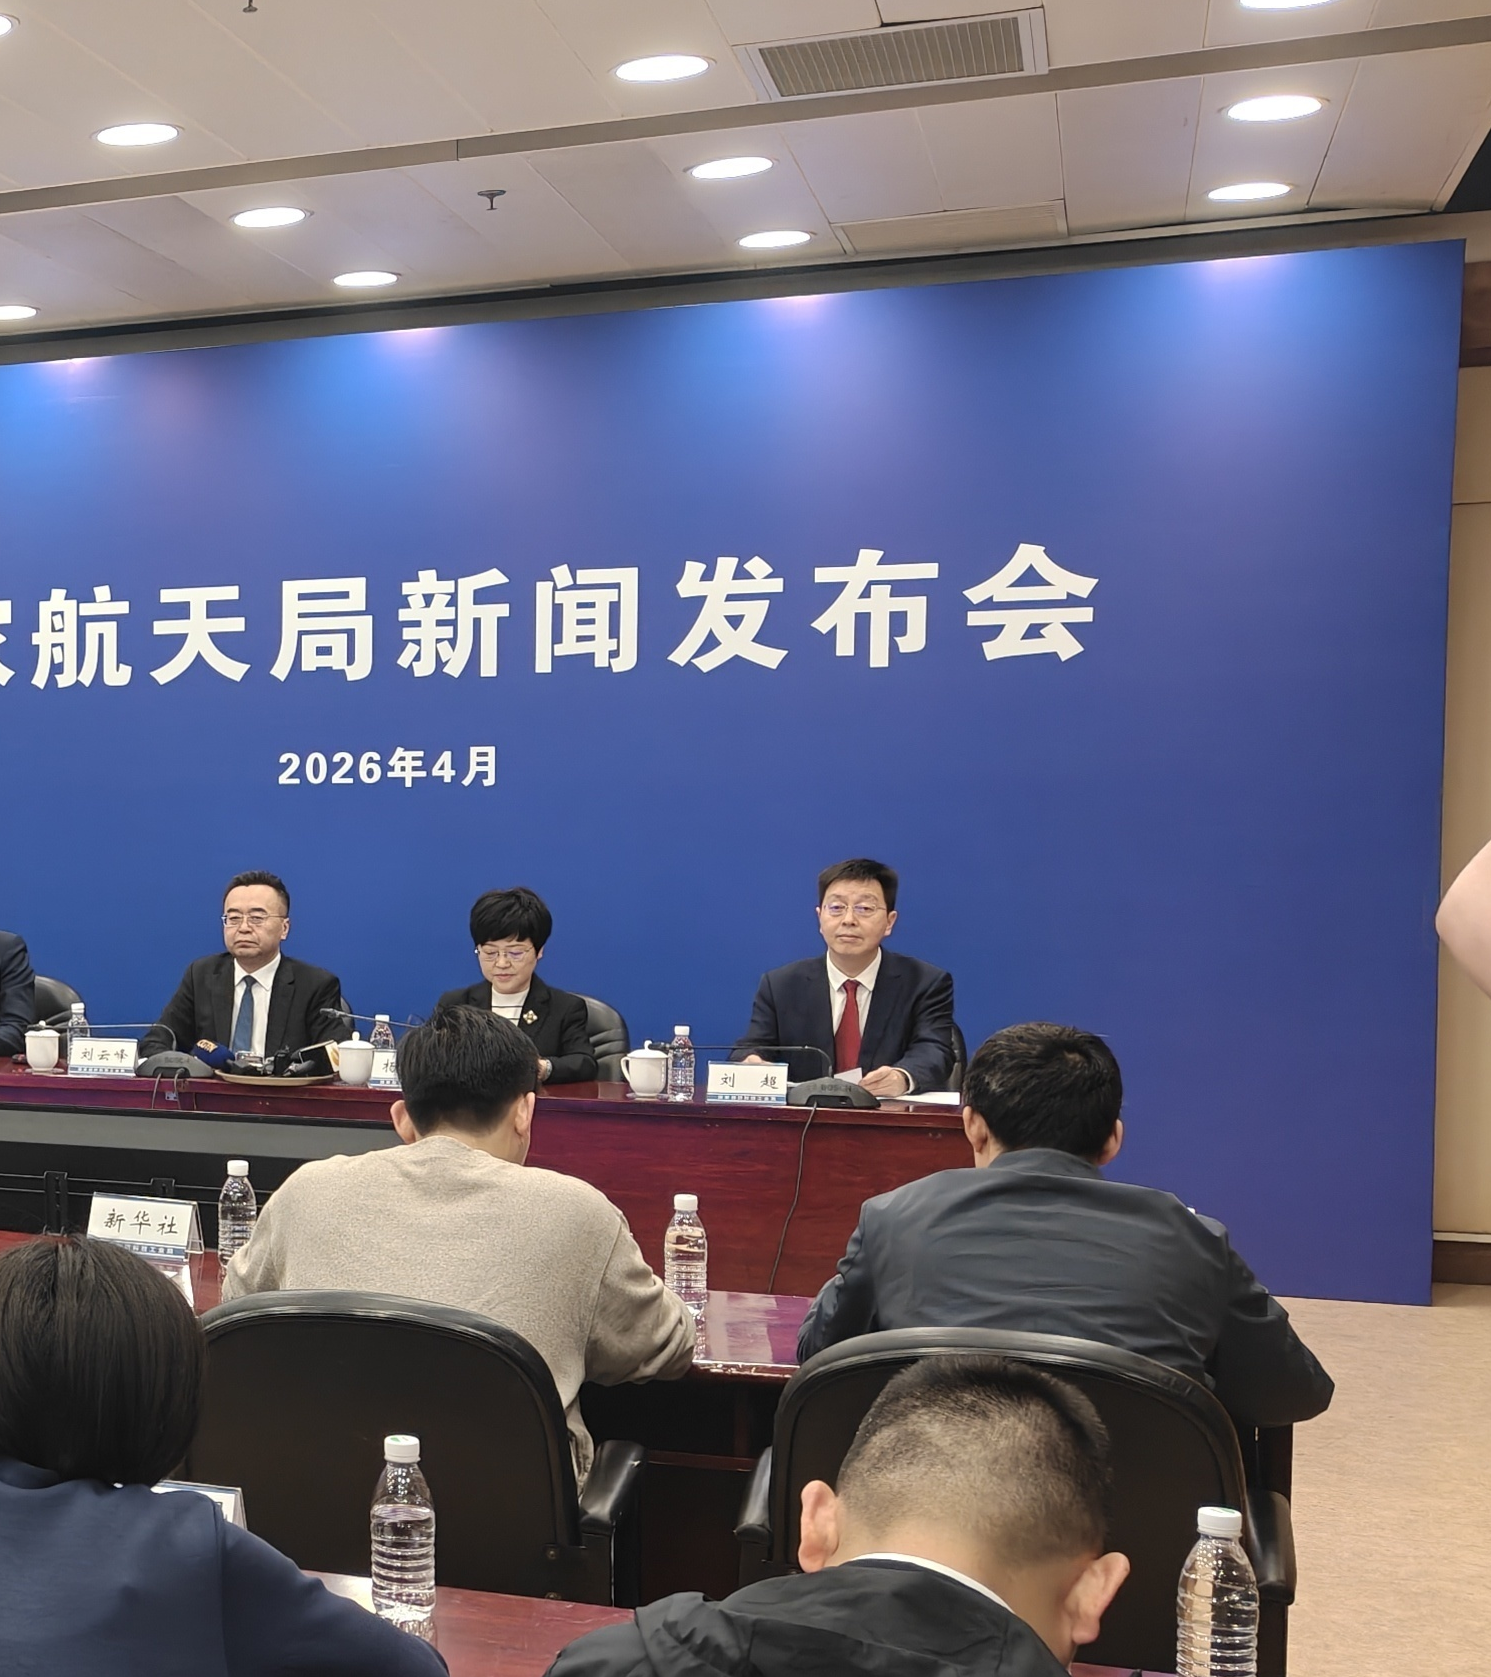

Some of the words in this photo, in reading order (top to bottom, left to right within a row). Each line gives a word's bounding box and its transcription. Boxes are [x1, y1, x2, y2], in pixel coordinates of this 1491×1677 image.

[277, 746, 499, 788] 2026年4月
[80, 1047, 129, 1062] 刘云峰
[104, 1208, 179, 1235] 新华社
